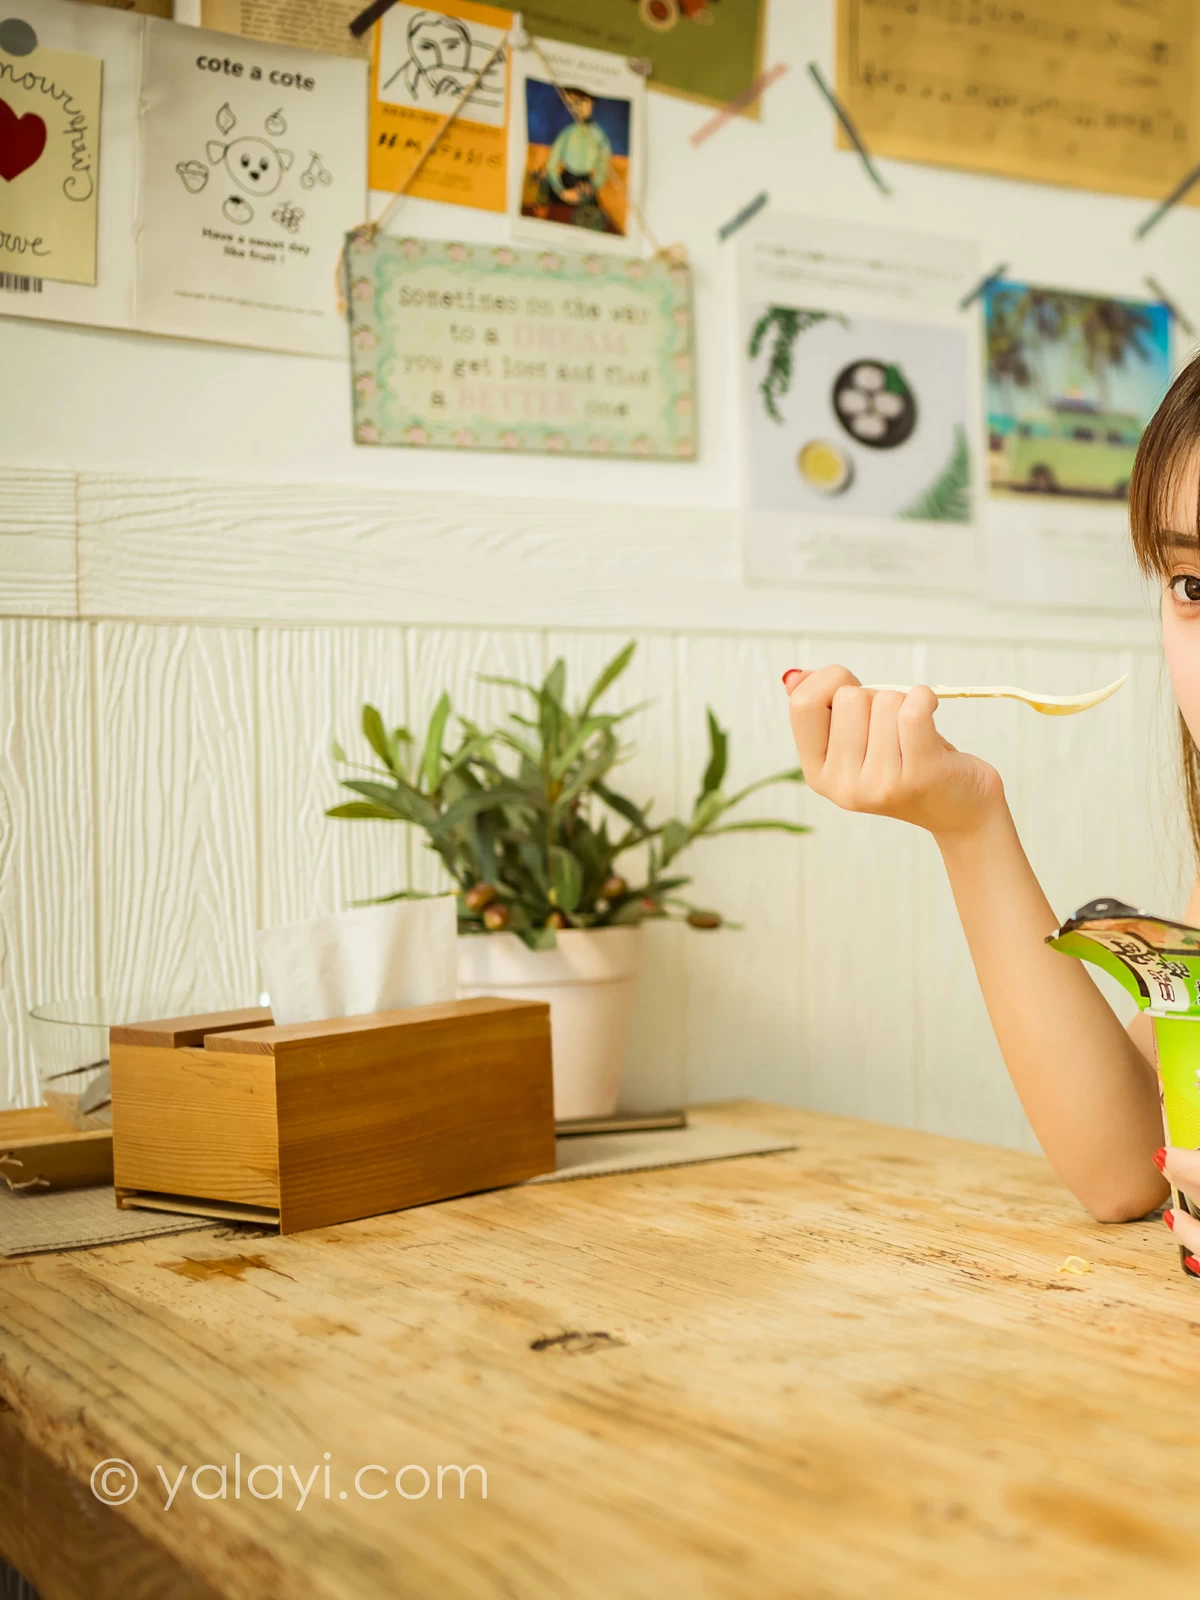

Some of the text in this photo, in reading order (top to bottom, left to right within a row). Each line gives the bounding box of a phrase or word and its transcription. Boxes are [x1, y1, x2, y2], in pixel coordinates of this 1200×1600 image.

[196, 54, 316, 92] cote a cote
[449, 319, 476, 345] to
